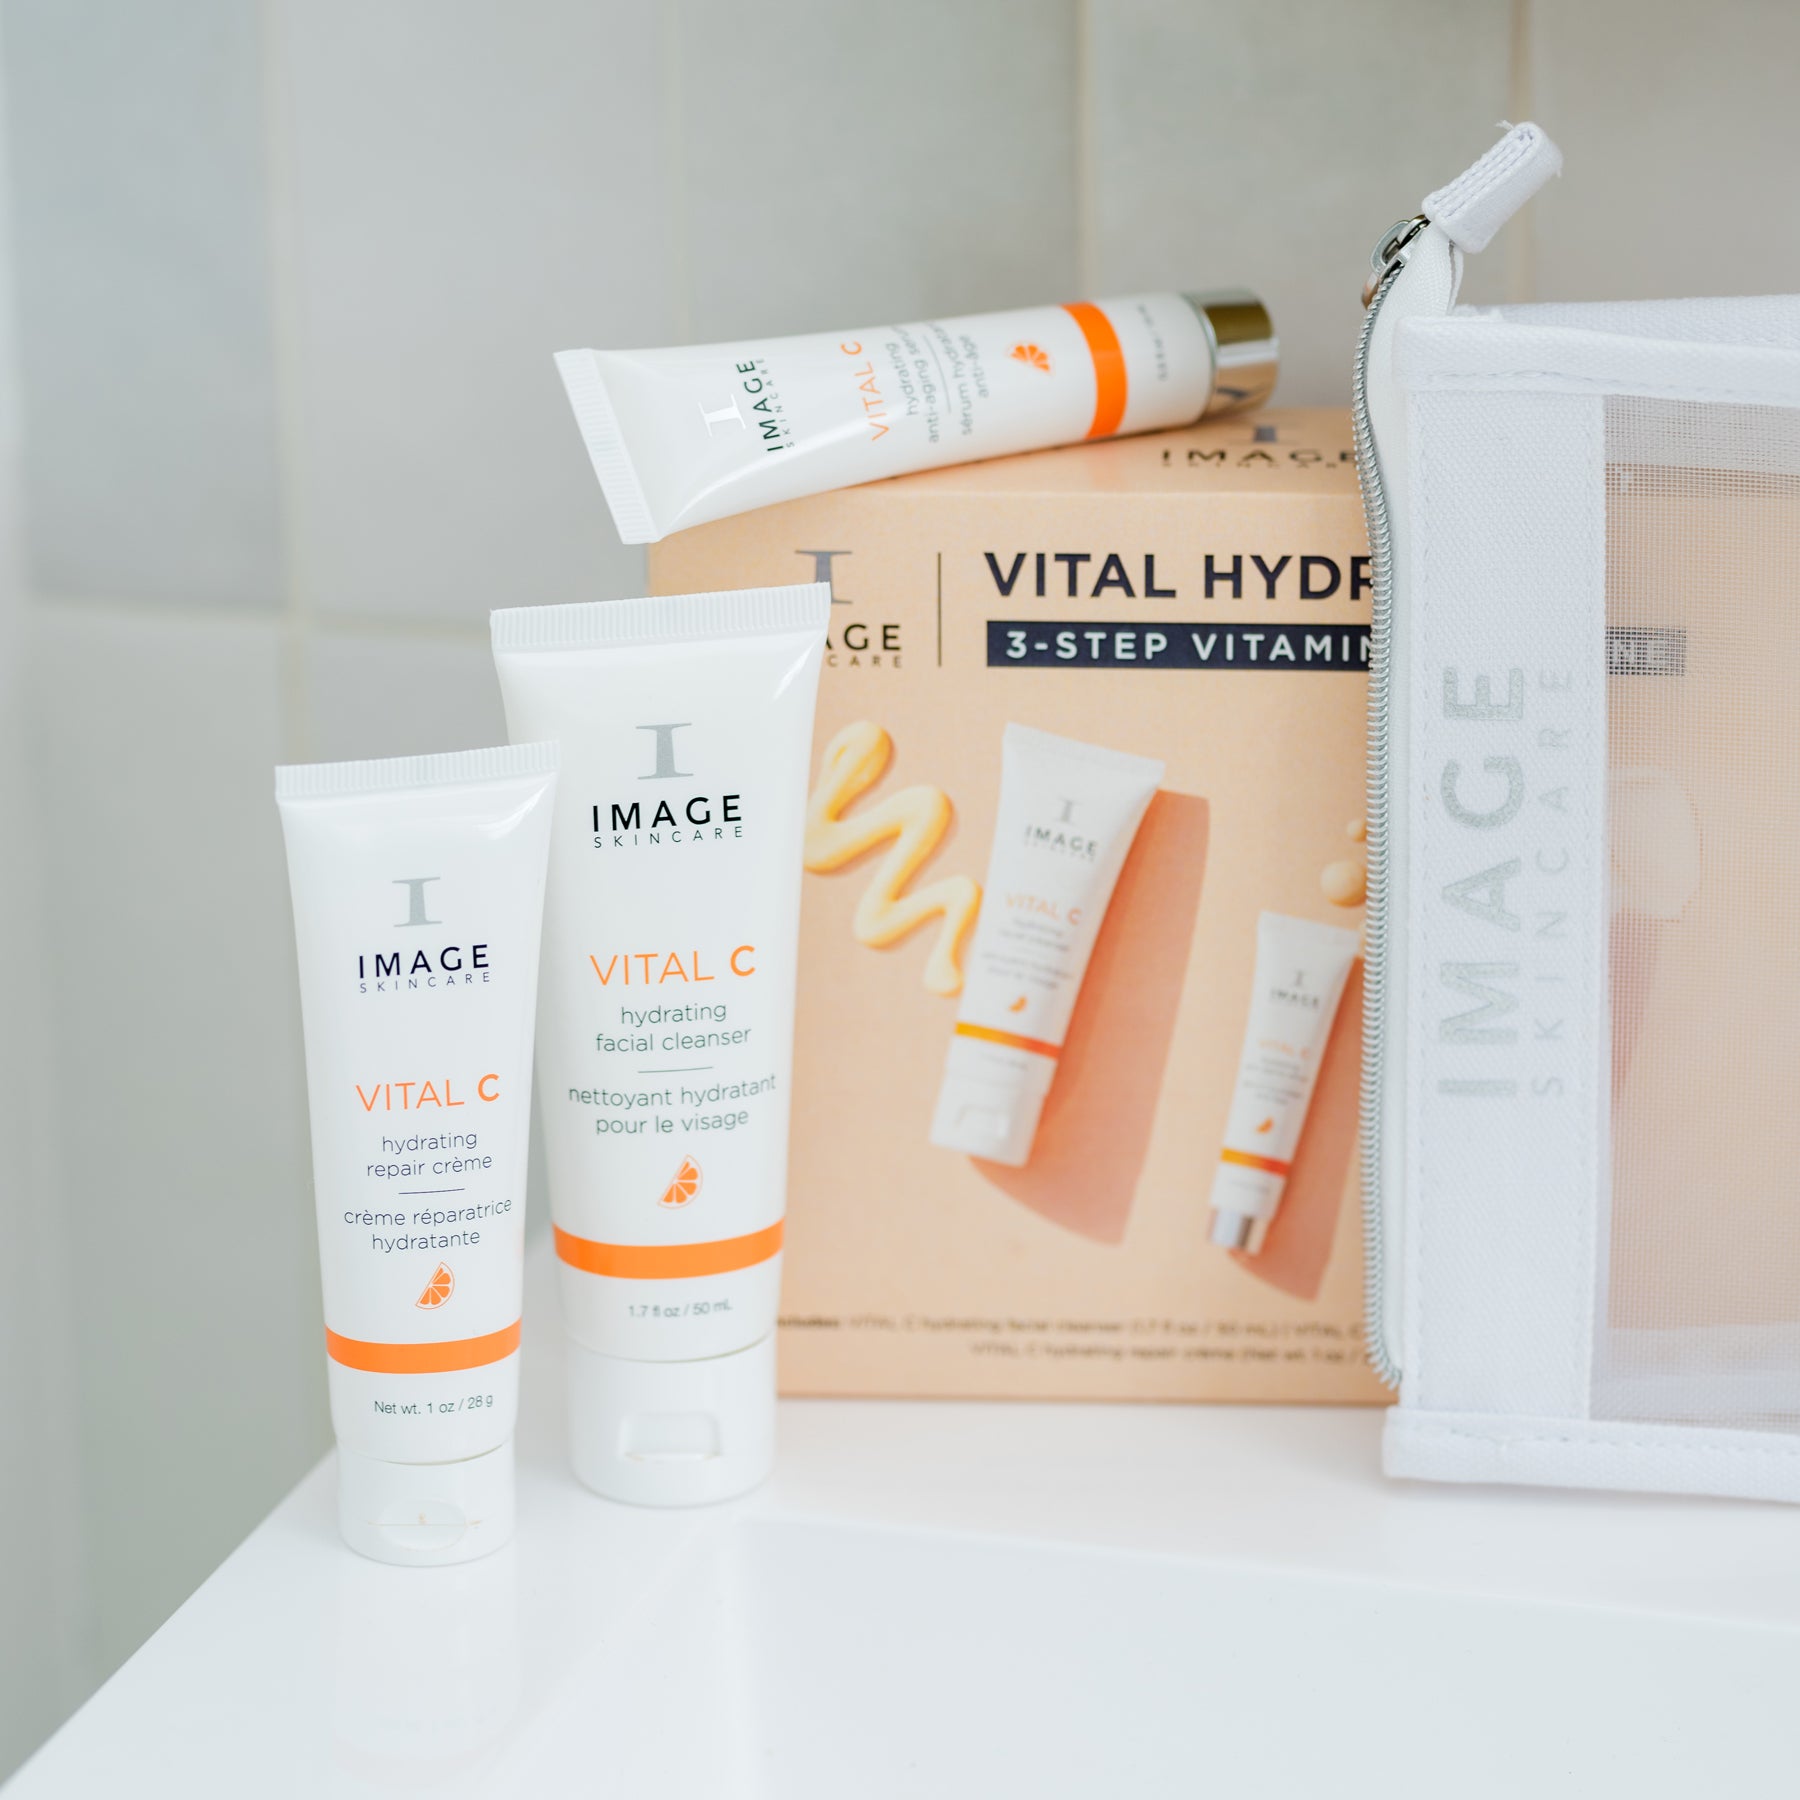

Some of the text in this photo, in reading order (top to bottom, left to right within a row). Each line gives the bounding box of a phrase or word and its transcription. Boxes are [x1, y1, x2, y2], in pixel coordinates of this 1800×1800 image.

[840, 338, 890, 441] VITAL C
[885, 342, 920, 416] hydrating
[736, 361, 784, 451] IMAGE
[914, 359, 940, 443] anti-aging
[984, 553, 1178, 598] VITAL
[1005, 630, 1169, 661] 3-STEP
[593, 794, 742, 832] IMAGE
[594, 826, 743, 848] SKINCARE
[1024, 824, 1098, 857] IMAGE
[1437, 666, 1526, 1099] IMAGE
[1530, 669, 1572, 1098] SKINCARE
[359, 944, 489, 979] IMAGE
[590, 945, 756, 985] VITAL C
[359, 971, 490, 994] SKINCARE
[621, 1003, 727, 1028] hydrating
[596, 1028, 752, 1052] facial cleanser
[356, 1073, 500, 1112] VITAL C
[568, 1074, 776, 1110] nettoyant hydratant
[596, 1110, 750, 1135] pour le visage
[382, 1132, 478, 1155] hydrating
[367, 1155, 493, 1179] repair crème
[344, 1199, 512, 1226] crème réparatrice
[372, 1230, 481, 1253] hydratante
[628, 1305, 649, 1318] 1.7
[664, 1307, 680, 1318] oz
[693, 1302, 711, 1315] 50
[374, 1400, 397, 1414] Net
[401, 1403, 421, 1415] wt.
[427, 1402, 433, 1414] 1
[439, 1403, 455, 1413] oz
[486, 1395, 494, 1408] g
